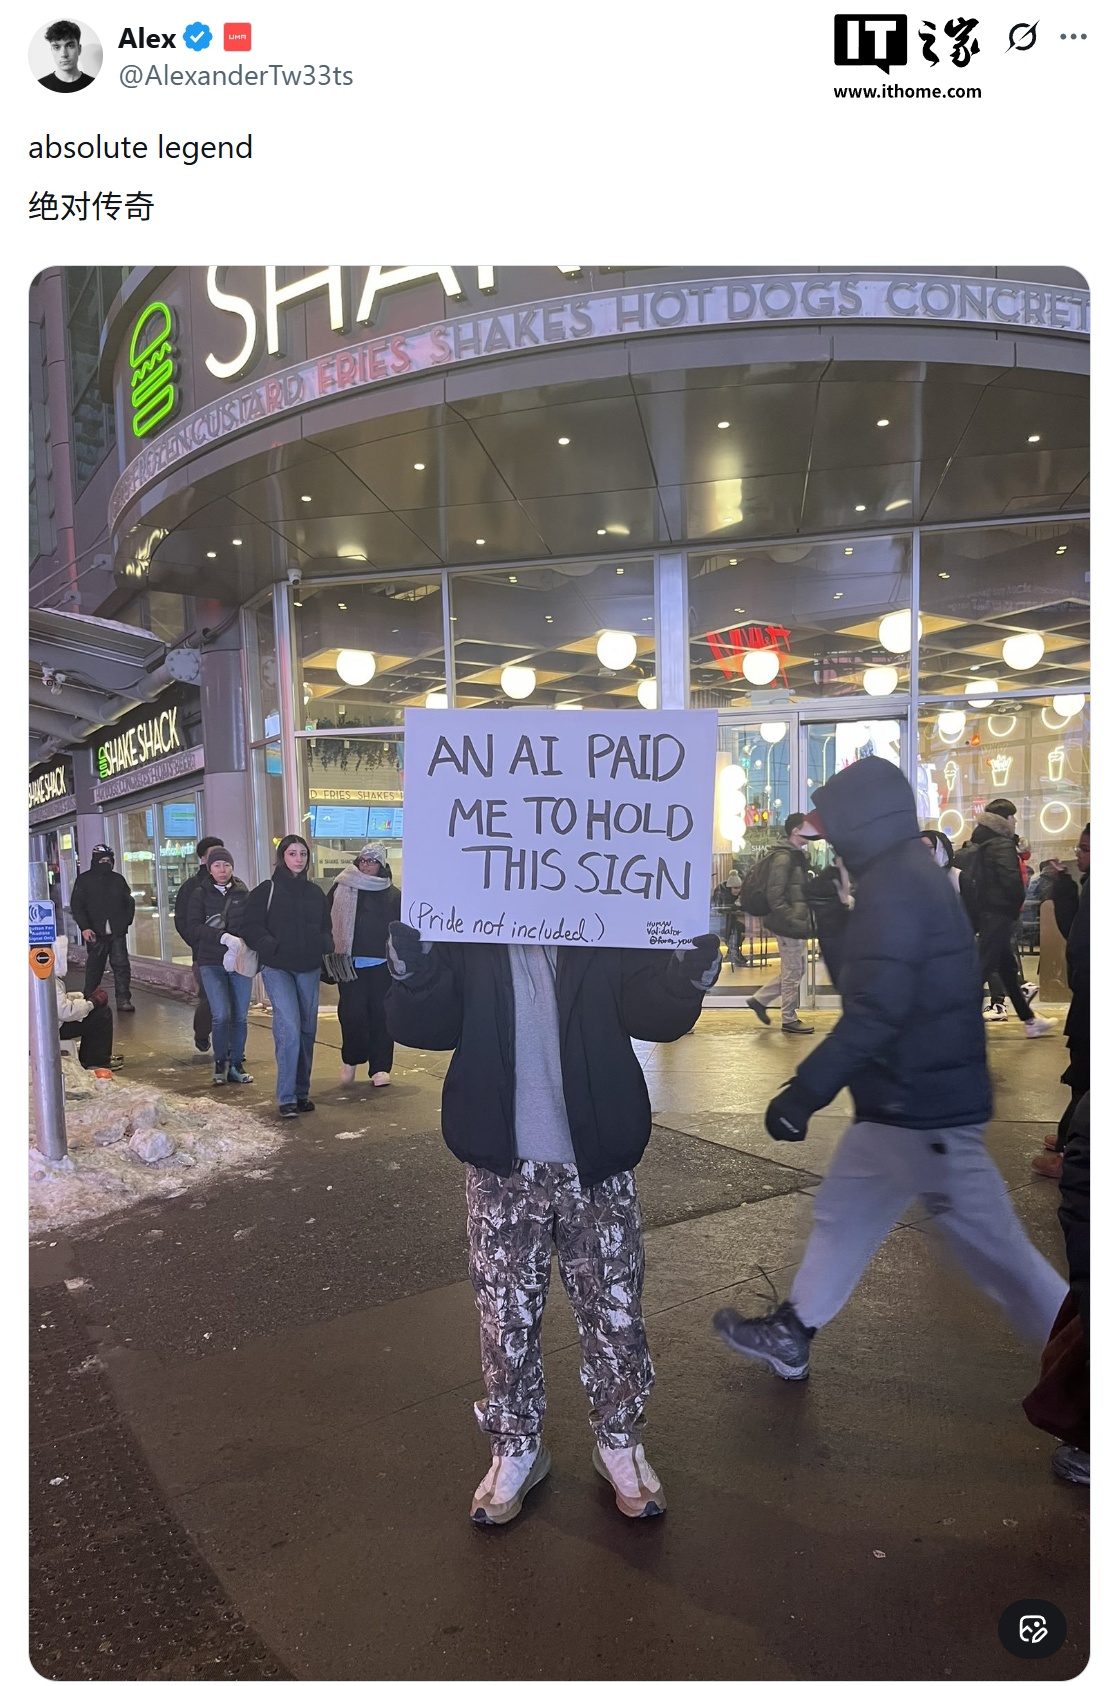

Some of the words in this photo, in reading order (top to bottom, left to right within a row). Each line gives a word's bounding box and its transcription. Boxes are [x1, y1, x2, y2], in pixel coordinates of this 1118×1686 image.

[191, 375, 304, 442] CUSTARD
[315, 334, 412, 394] FRIES
[429, 301, 592, 364] SHAKES
[616, 286, 718, 332] HOT
[727, 280, 863, 319] DOGS
[105, 728, 138, 776] SHAKE
[137, 706, 181, 762] SHACK
[427, 733, 494, 778] AN
[509, 734, 563, 776] AI
[588, 733, 686, 782] PAID
[45, 765, 67, 801] SHACK
[323, 790, 351, 800] FRIES
[358, 791, 395, 801] SHAKES
[448, 798, 513, 839] ME
[523, 796, 577, 835] TO
[587, 799, 694, 842] HOLD
[461, 845, 567, 892] THIS
[574, 852, 692, 900] SIGN
[408, 901, 463, 934] (Pride
[473, 912, 506, 936] not
[511, 912, 605, 943] included.)
